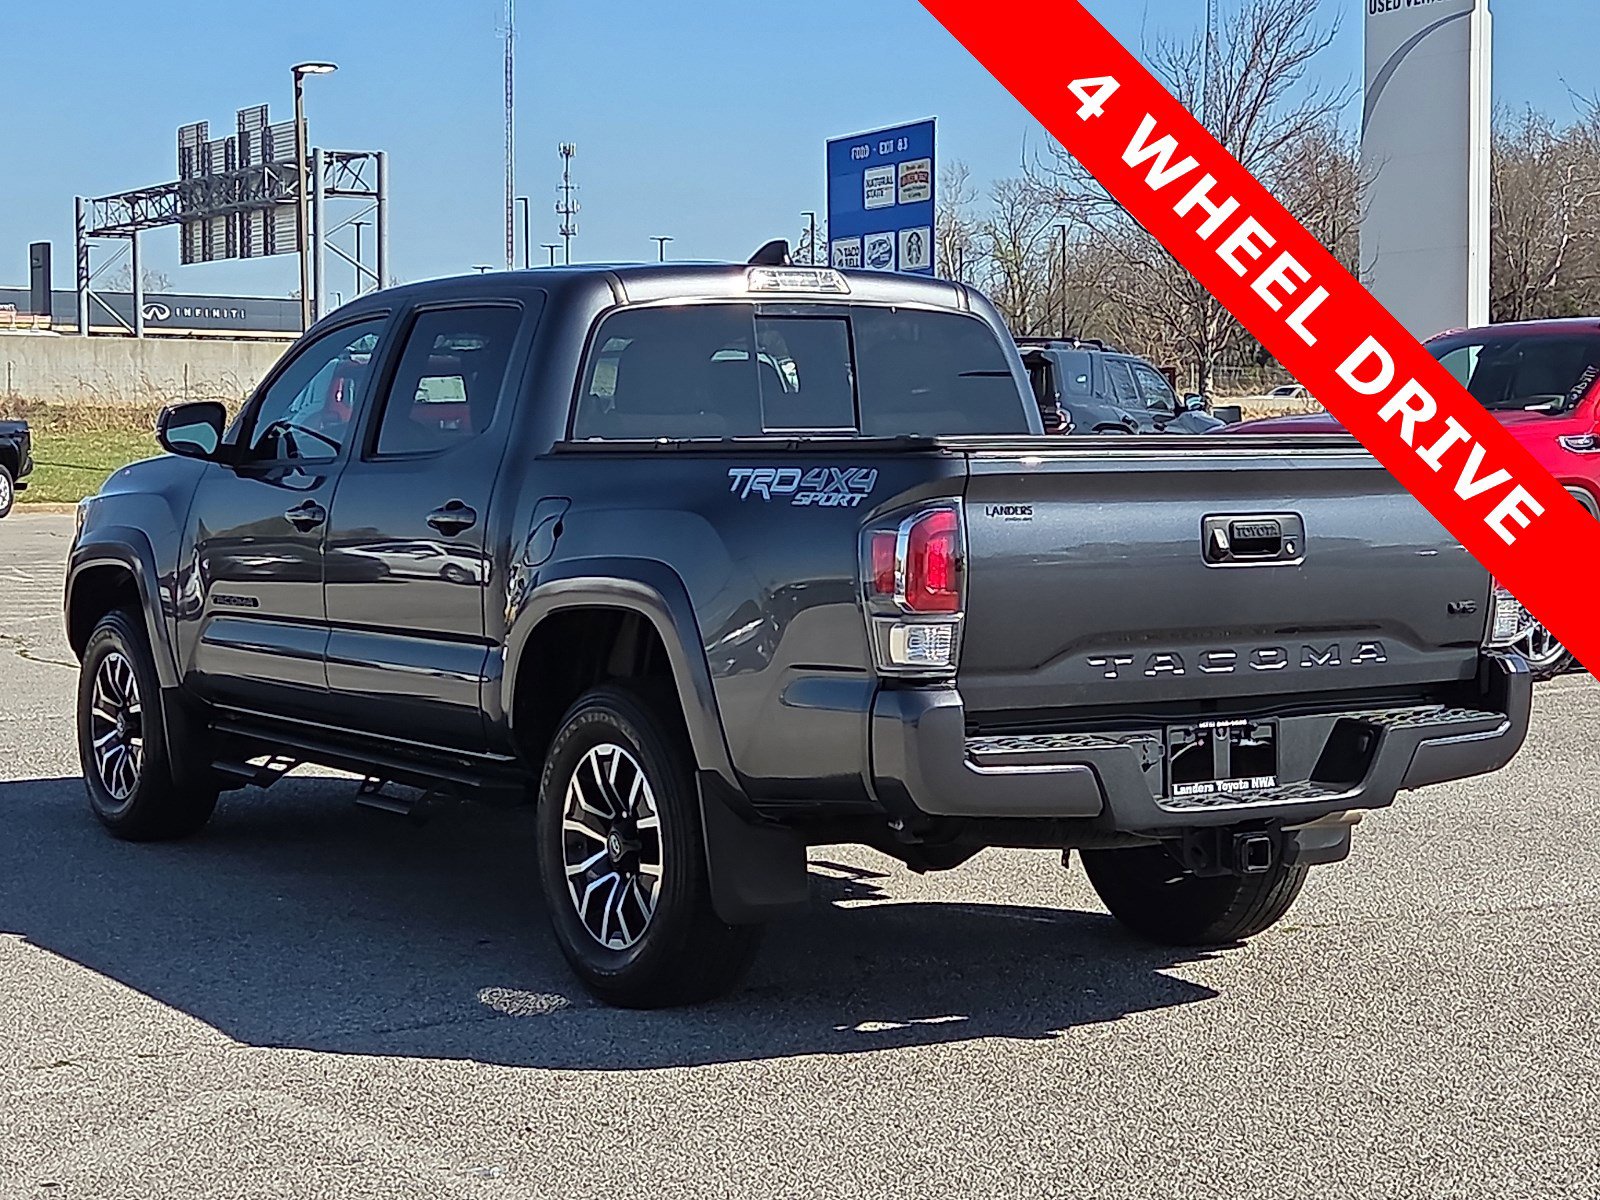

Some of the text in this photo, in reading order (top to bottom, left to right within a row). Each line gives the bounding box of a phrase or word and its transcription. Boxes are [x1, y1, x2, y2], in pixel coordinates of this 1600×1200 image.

[1369, 0, 1400, 15] USED
[851, 144, 870, 160] FOOD
[879, 139, 894, 155] EXIT
[865, 175, 894, 188] NATURAL
[865, 188, 884, 199] STATE
[174, 307, 247, 319] INFINITI
[791, 492, 869, 507] SPORT
[985, 505, 1034, 517] LANDERS
[1235, 526, 1279, 537] TOYOTA
[1447, 599, 1477, 614] V6
[1086, 641, 1387, 679] TACOMA
[1173, 776, 1276, 796] Landers Toyota NWA
